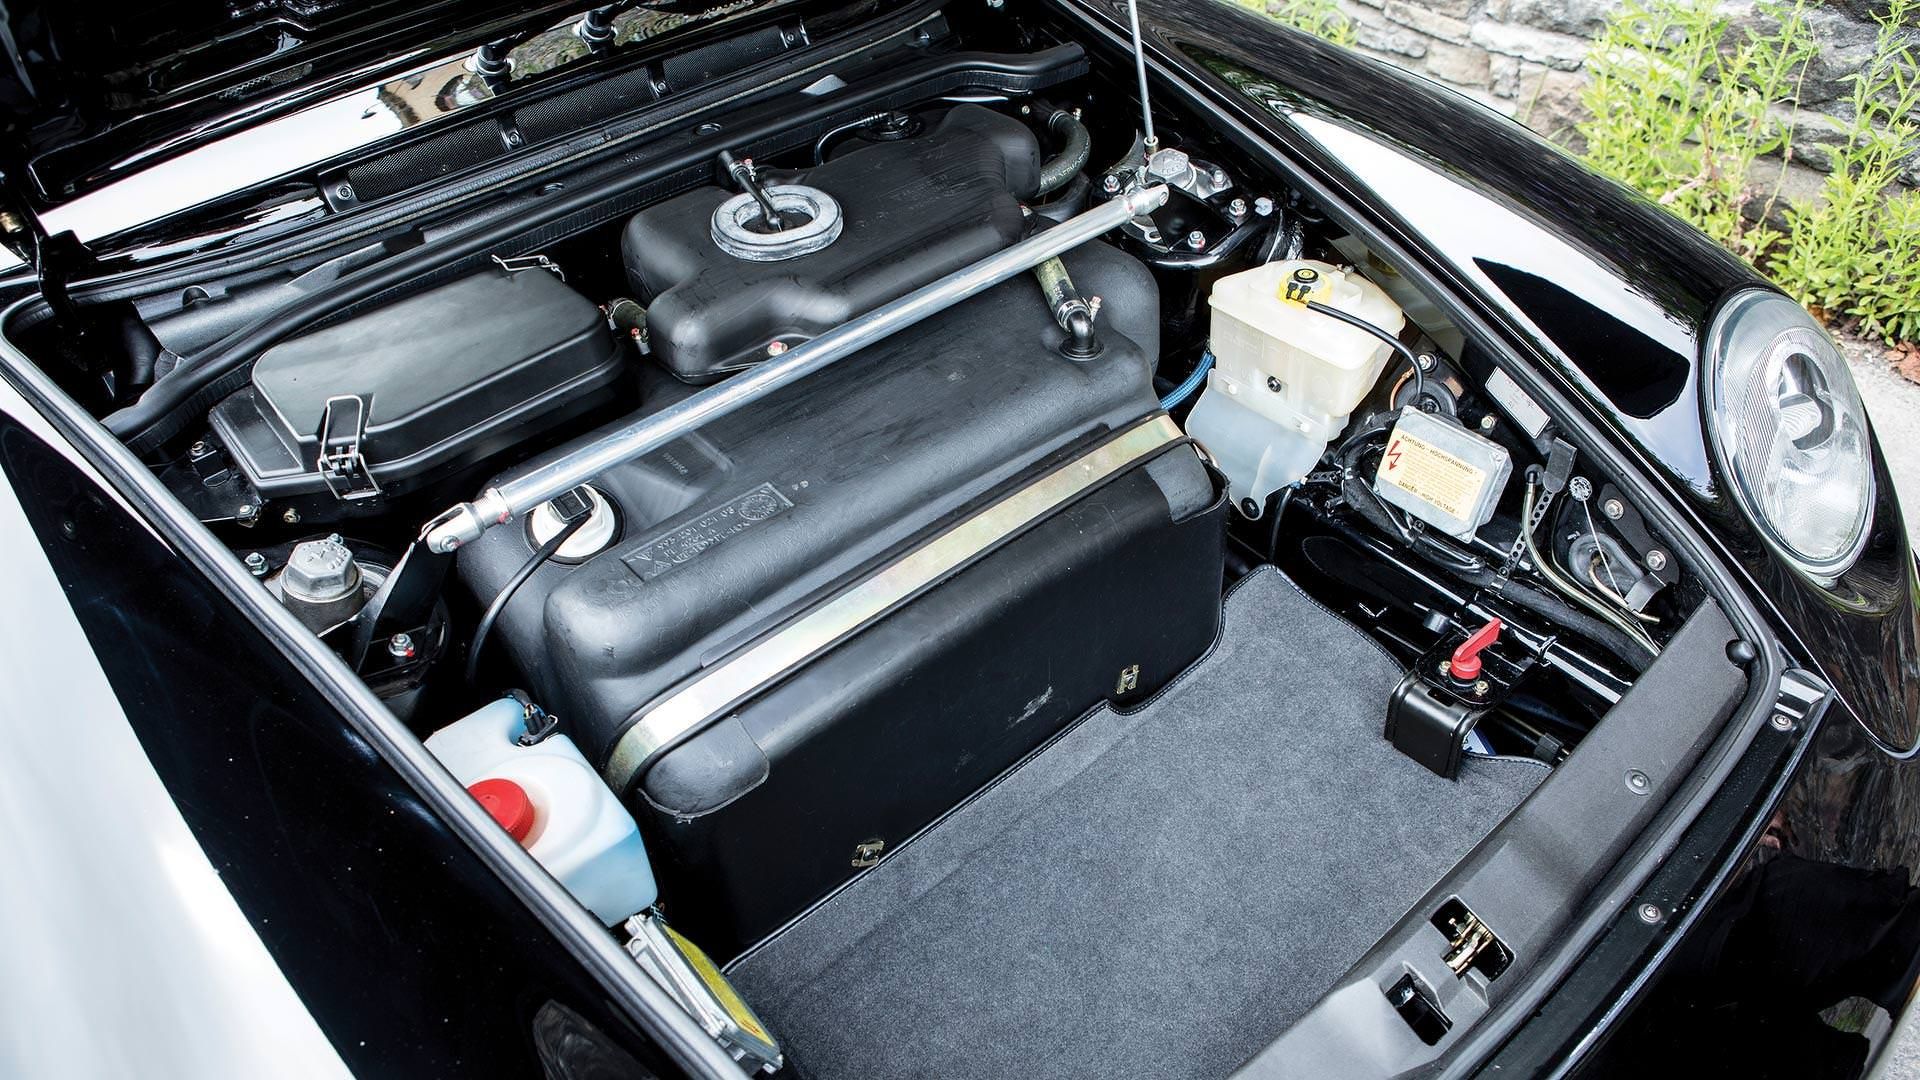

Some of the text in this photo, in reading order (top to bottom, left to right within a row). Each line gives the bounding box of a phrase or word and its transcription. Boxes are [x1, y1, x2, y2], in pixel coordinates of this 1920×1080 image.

[1401, 434, 1425, 450] ACHTUNG
[1430, 449, 1474, 475] HOCHSPANNUNG
[1398, 480, 1418, 493] DANGER
[1434, 498, 1456, 514] VOLTAGE
